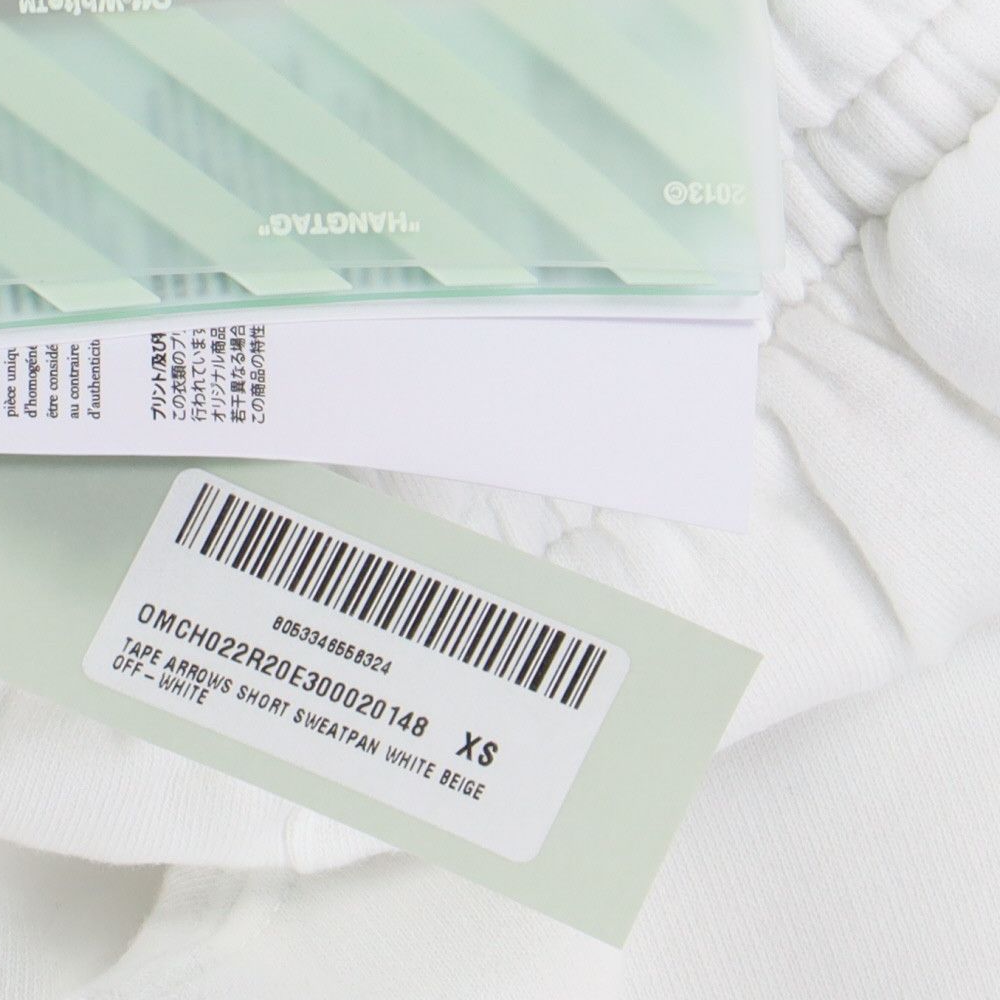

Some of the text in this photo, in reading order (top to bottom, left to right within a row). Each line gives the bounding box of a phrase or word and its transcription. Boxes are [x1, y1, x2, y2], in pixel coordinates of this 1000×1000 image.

[663, 181, 746, 206] 2013©
[258, 210, 420, 237] "HANGTAG"
[3, 386, 19, 418] pièce
[67, 344, 80, 419] au contraire
[210, 327, 226, 422] オリジナル商品
[250, 325, 265, 424] この商品の特性
[121, 637, 486, 801] TAPE ARROWS SHORT SWEATPAN WHITE BEIGE
[456, 731, 499, 767] XS
